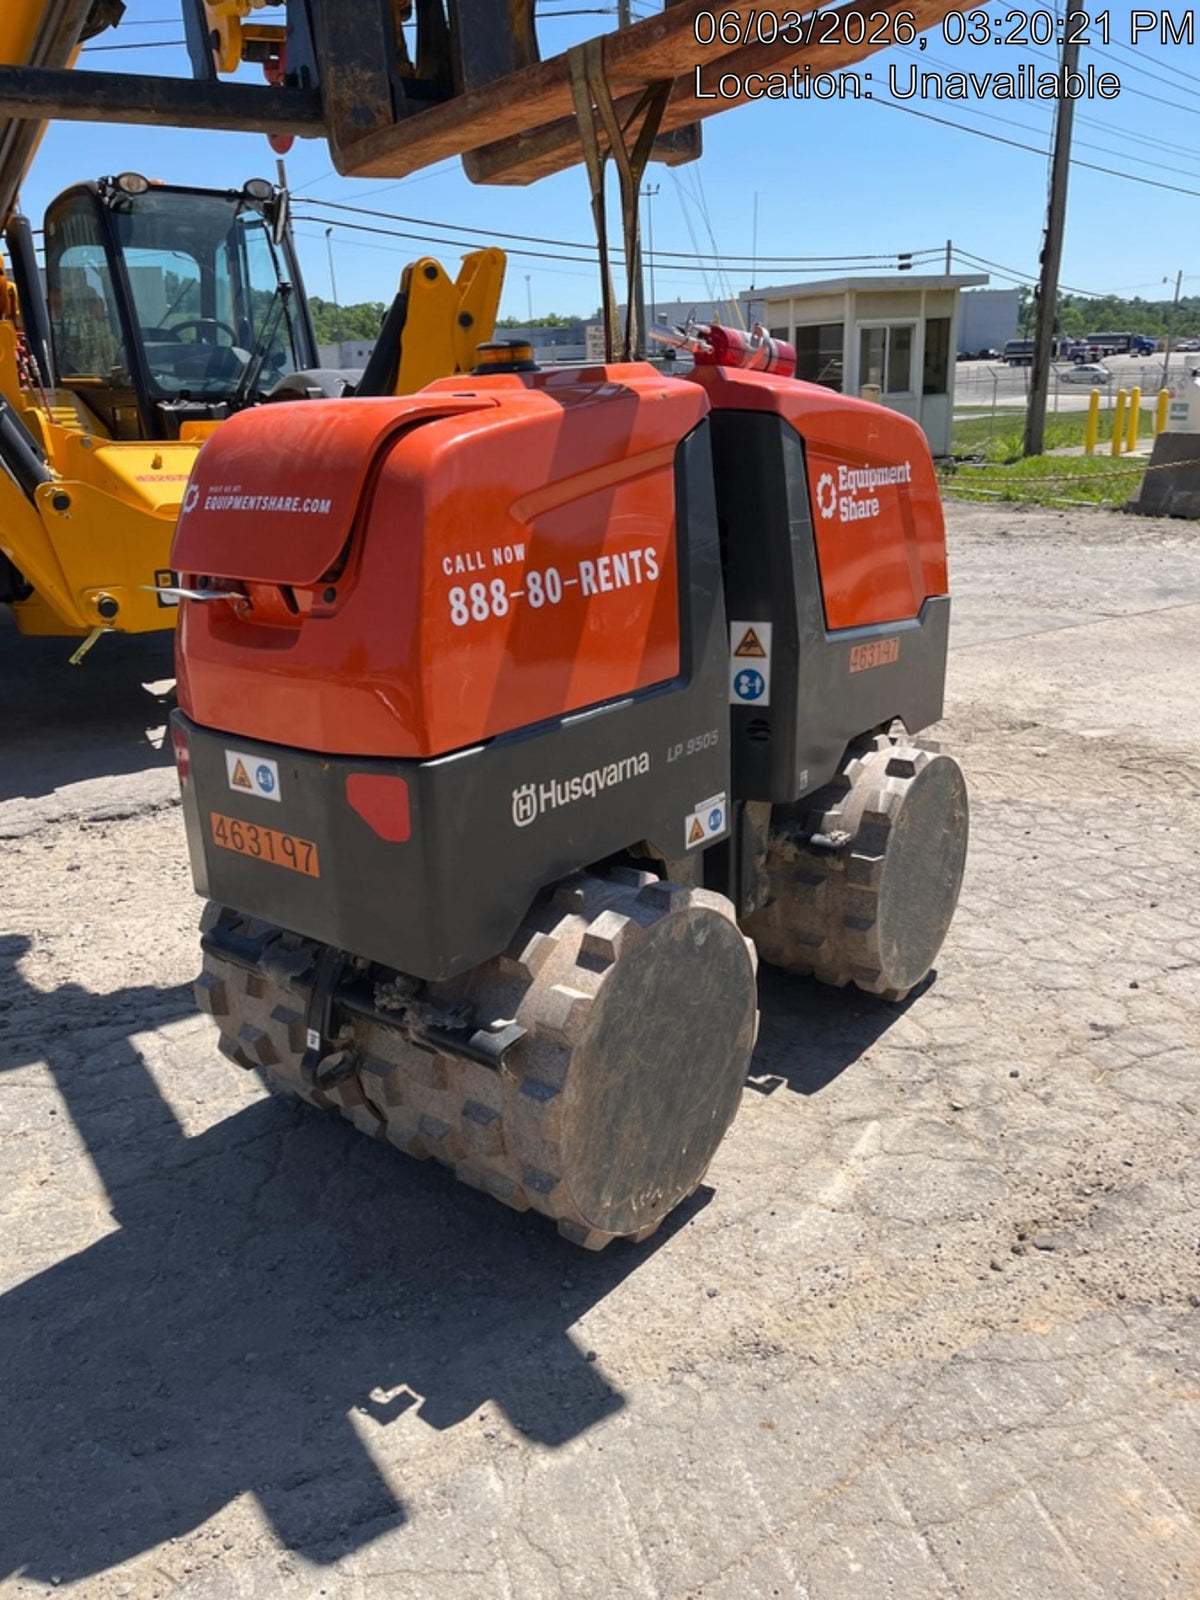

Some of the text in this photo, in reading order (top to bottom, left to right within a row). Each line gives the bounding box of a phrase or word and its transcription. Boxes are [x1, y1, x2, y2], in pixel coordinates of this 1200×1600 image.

[837, 460, 912, 495] Equipment
[204, 495, 332, 514] EQUIPMENTSHARE.COM
[839, 496, 880, 522] Share
[442, 543, 526, 576] CALL NOW
[448, 547, 660, 627] 888-80-RENTS
[851, 639, 898, 670] 463197
[666, 729, 719, 763] LP 9505
[539, 751, 650, 813] Husqvarna
[214, 817, 314, 872] 463197
